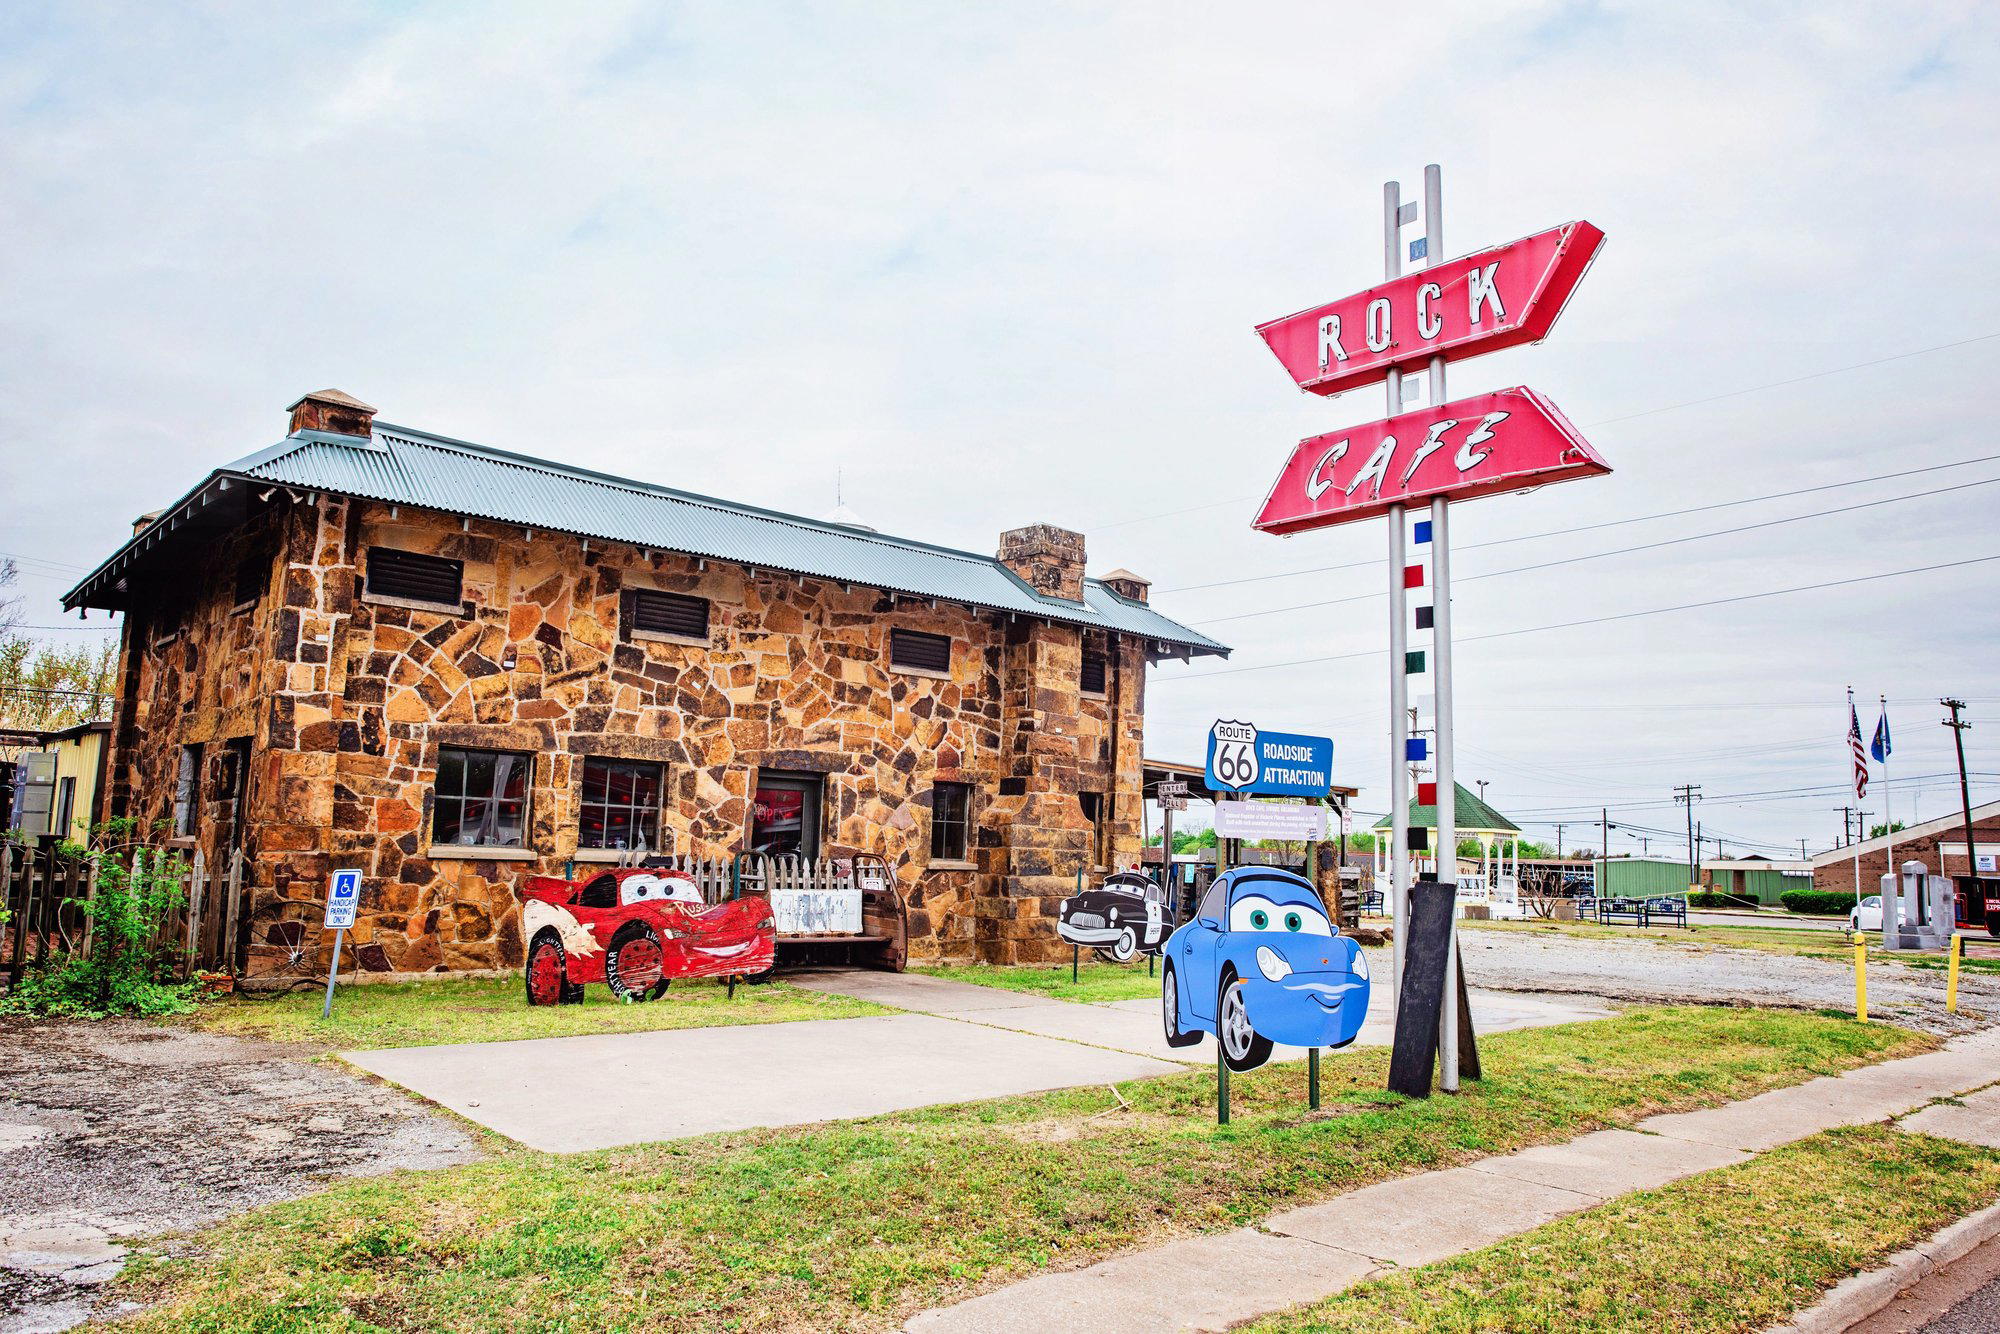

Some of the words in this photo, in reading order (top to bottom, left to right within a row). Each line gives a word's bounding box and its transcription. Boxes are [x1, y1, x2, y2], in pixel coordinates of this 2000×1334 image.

[1318, 261, 1506, 368] ROCK
[1305, 411, 1512, 502] CAFE
[1219, 726, 1251, 740] ROUTE
[1218, 742, 1253, 782] 66
[1263, 742, 1313, 763] ROADSIDE
[1262, 766, 1325, 787] ATTRACTION
[329, 907, 352, 916] PARKING
[333, 915, 347, 924] ONLY
